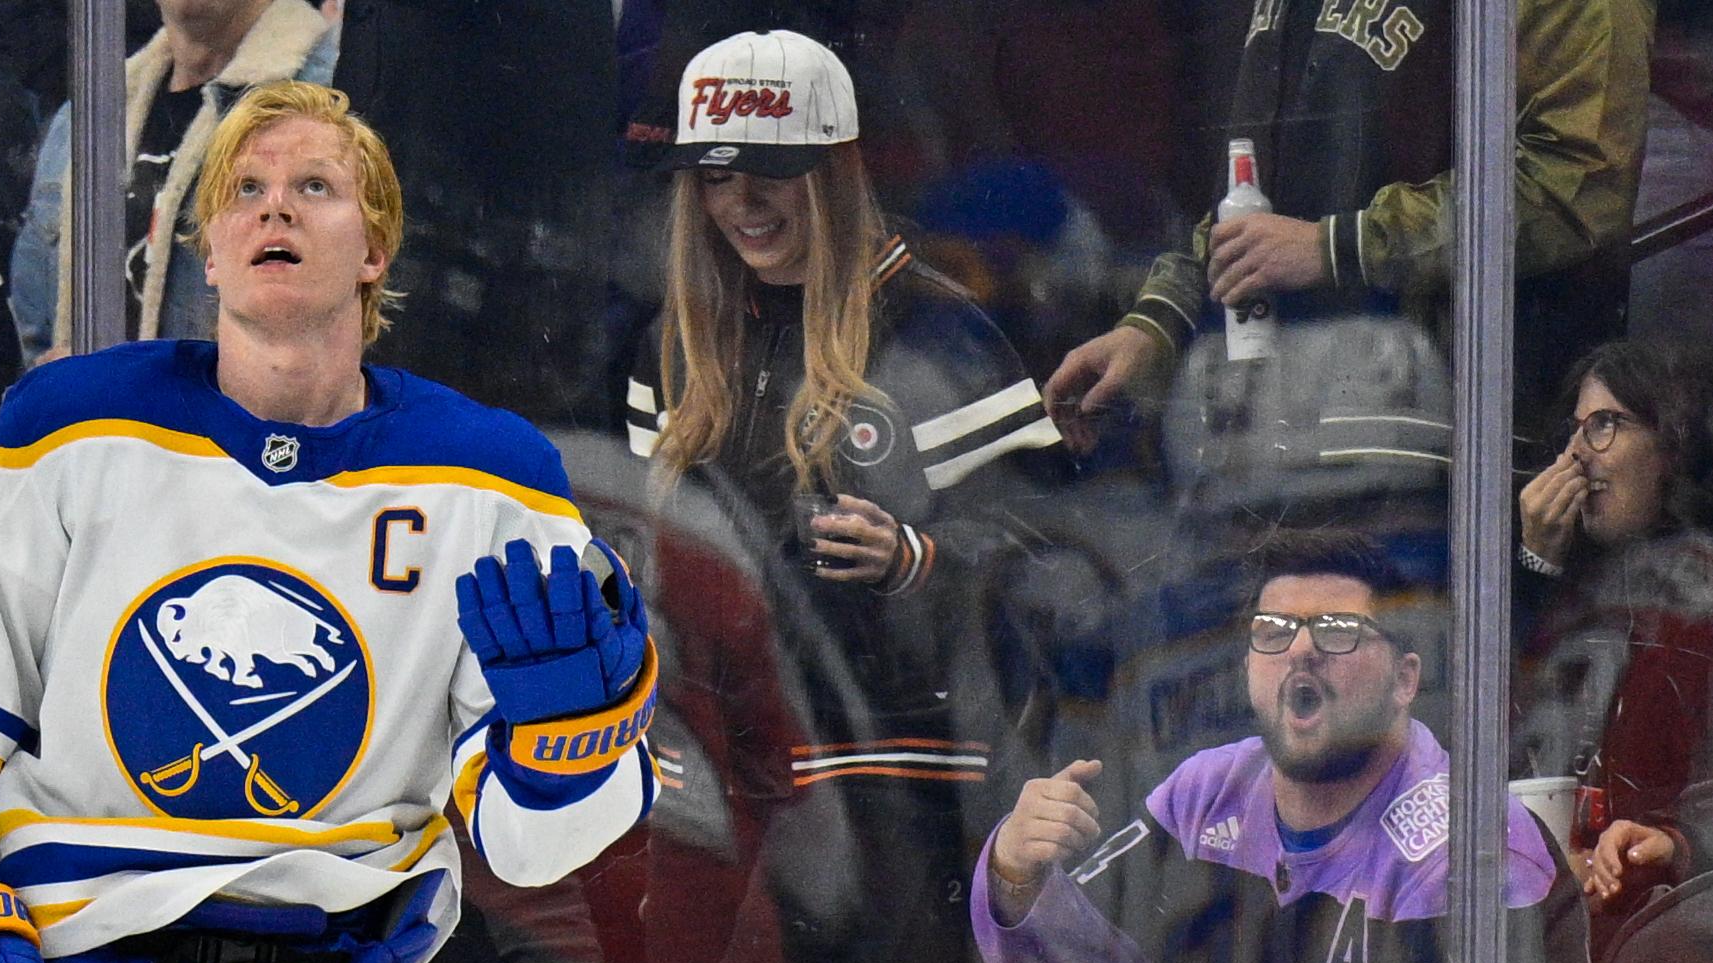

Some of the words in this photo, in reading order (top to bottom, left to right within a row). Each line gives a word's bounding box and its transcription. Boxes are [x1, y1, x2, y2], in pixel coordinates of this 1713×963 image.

[689, 77, 793, 130] Flyers
[261, 447, 291, 464] NHL
[368, 505, 428, 595] C
[1398, 796, 1448, 838] FIGHT
[1408, 816, 1448, 850] CAN
